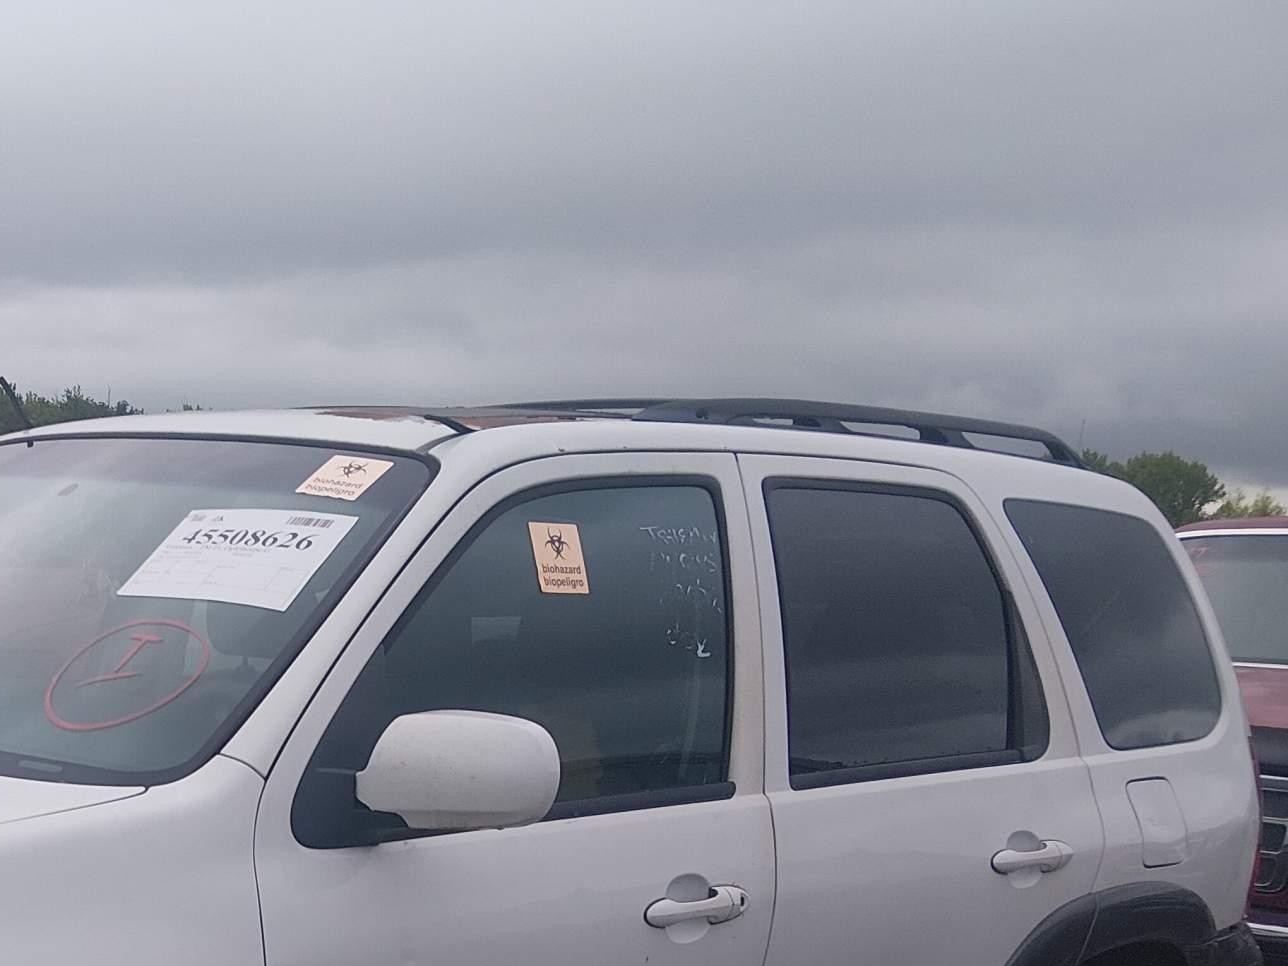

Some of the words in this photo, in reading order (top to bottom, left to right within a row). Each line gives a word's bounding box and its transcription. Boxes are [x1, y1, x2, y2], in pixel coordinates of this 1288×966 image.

[312, 477, 364, 489] biohazard
[305, 484, 356, 496] biopeligro
[182, 528, 321, 551] 45508626
[541, 562, 582, 575] biohazard
[543, 576, 584, 589] biopeligro
